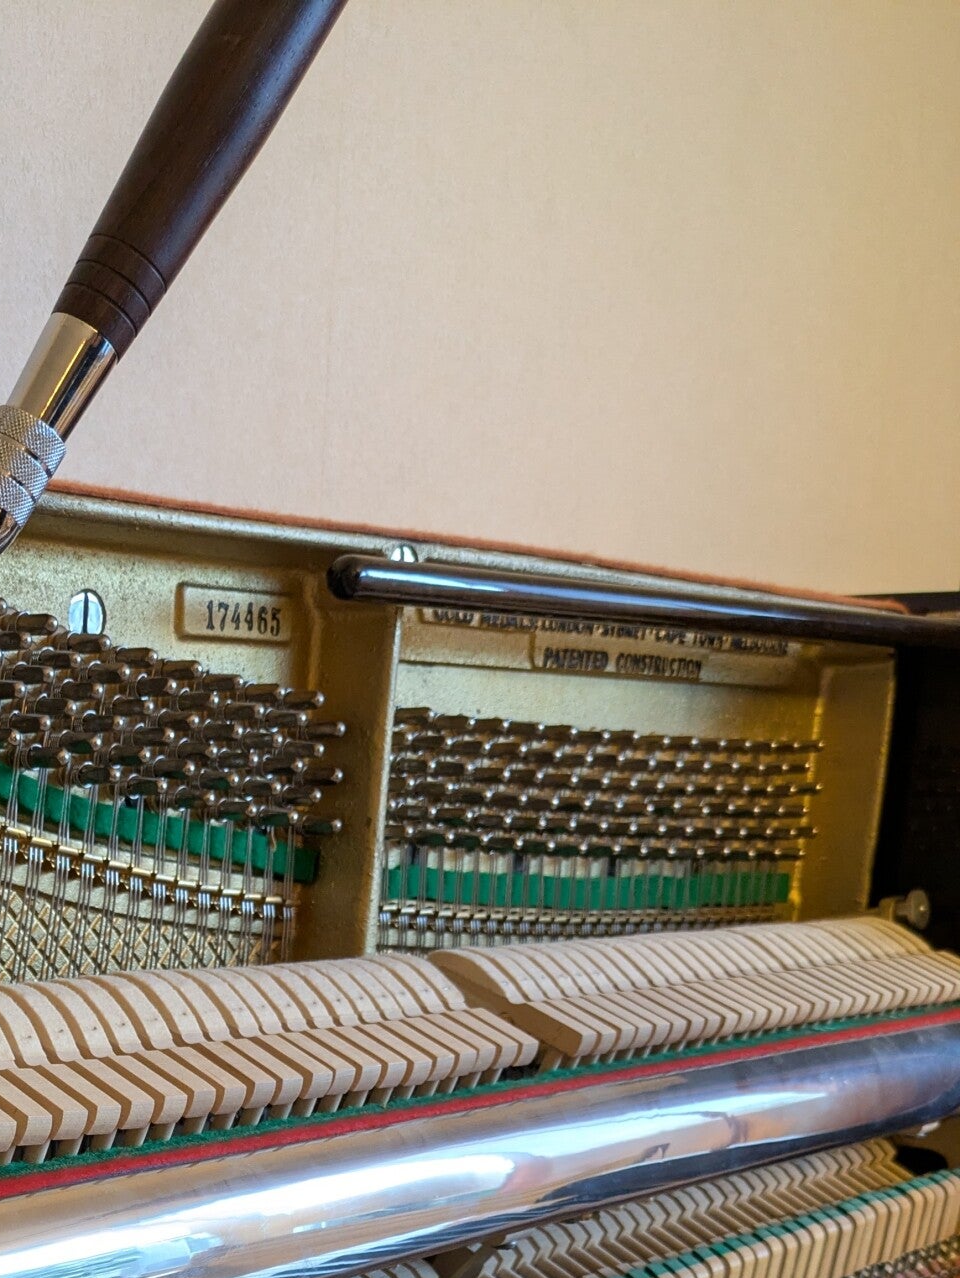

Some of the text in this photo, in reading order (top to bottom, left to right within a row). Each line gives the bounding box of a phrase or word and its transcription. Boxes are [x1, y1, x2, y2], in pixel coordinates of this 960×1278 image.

[206, 600, 281, 636] 174465
[542, 647, 702, 680] PATENTED CONSTRUCTION
